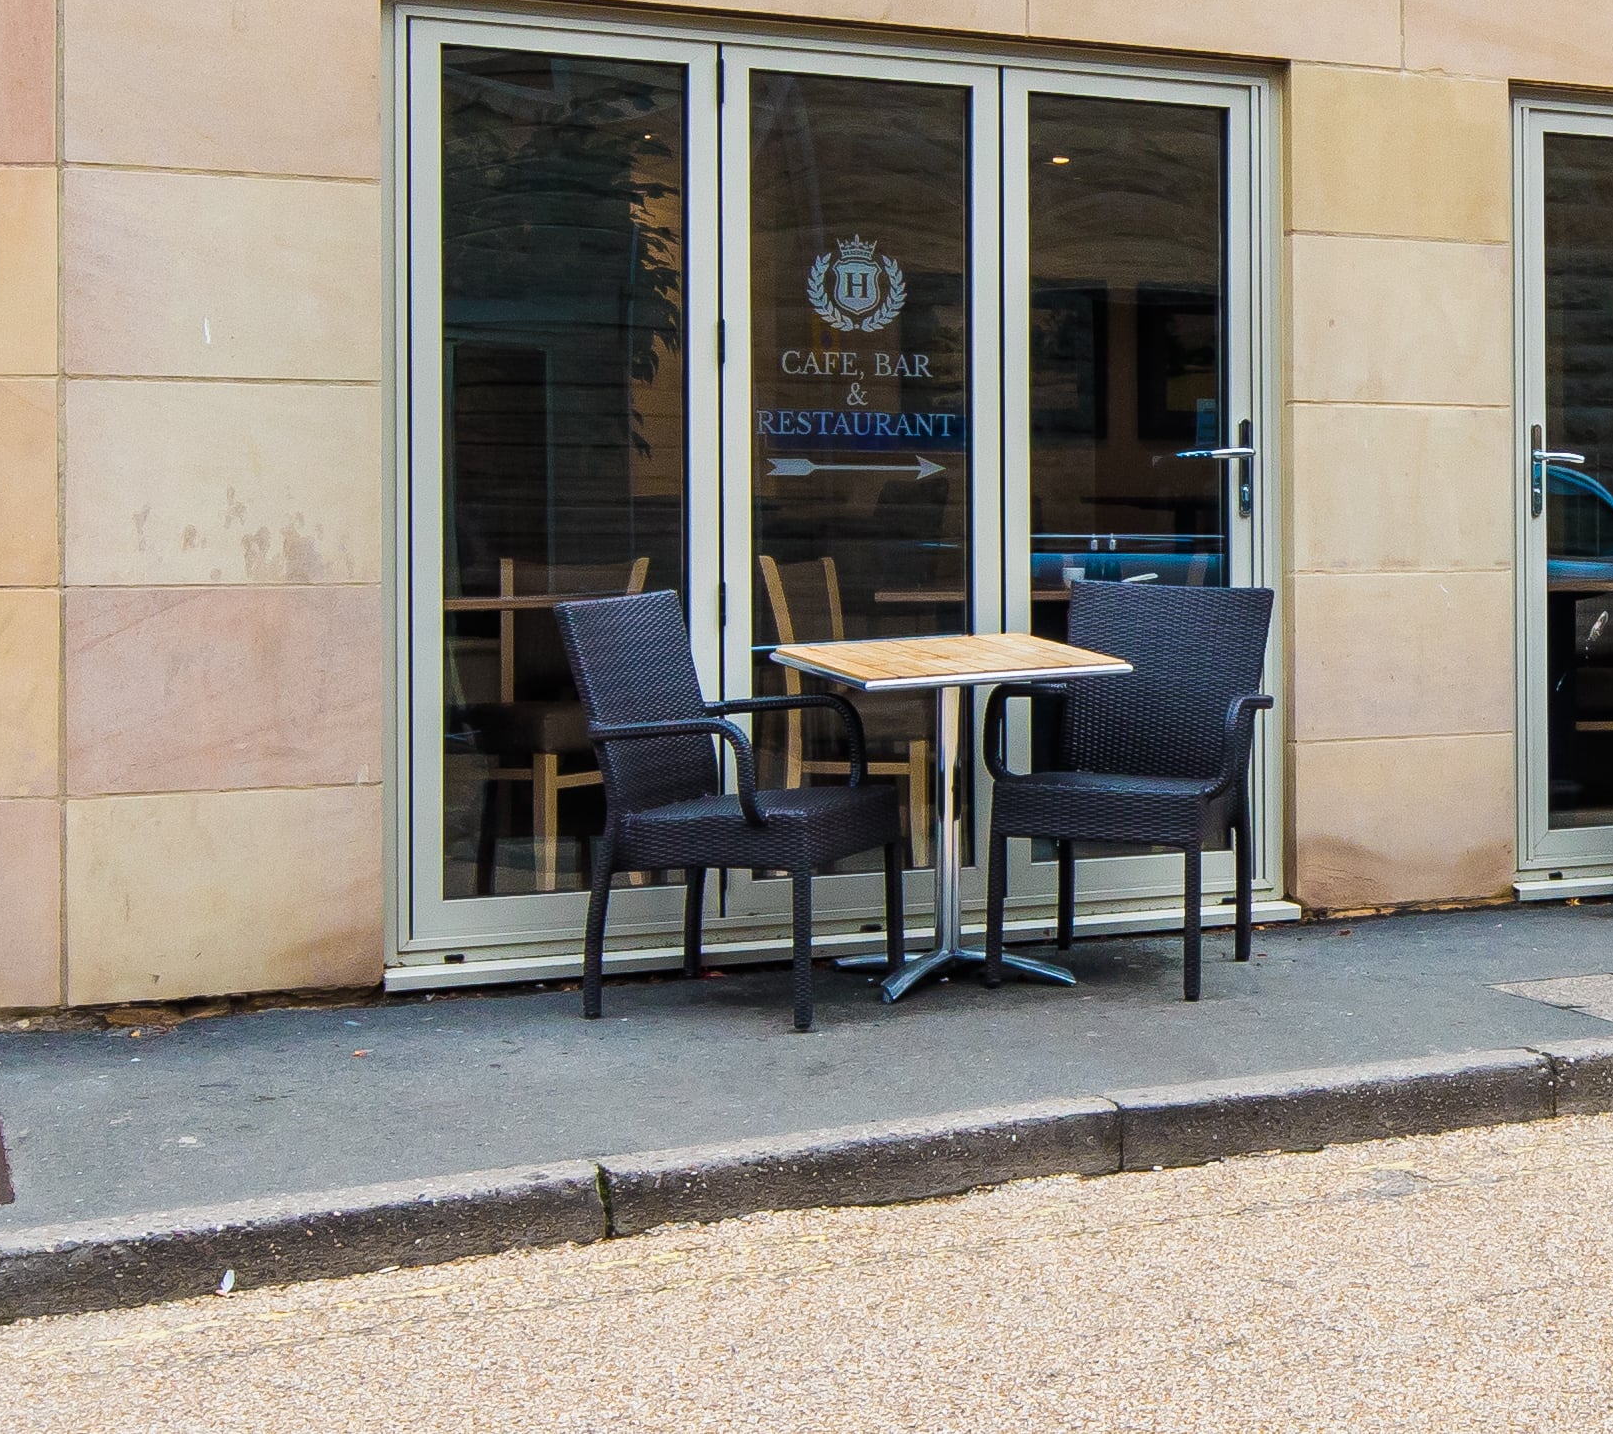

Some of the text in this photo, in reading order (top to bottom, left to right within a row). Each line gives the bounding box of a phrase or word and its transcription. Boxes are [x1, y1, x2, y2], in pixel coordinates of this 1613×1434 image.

[845, 272, 869, 299] H
[781, 350, 933, 380] CAFE, BAR
[846, 382, 869, 406] &
[756, 409, 955, 436] RESTAURANT
